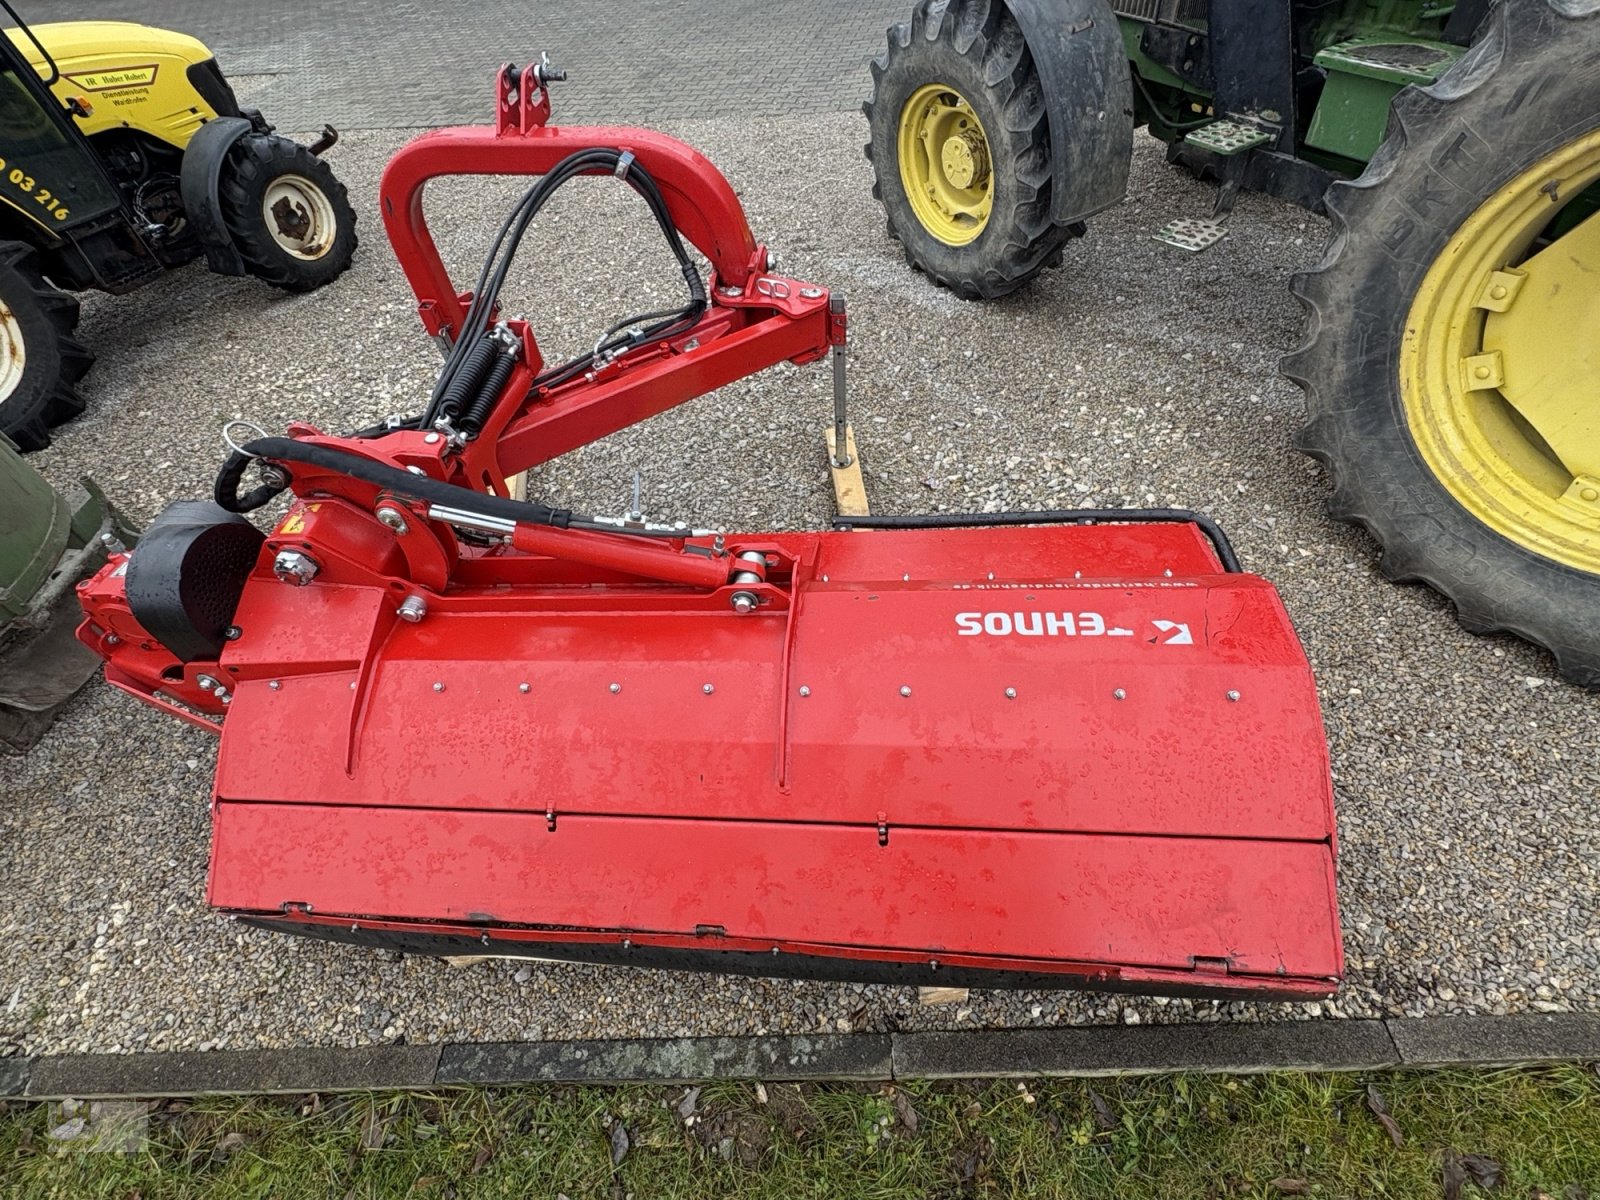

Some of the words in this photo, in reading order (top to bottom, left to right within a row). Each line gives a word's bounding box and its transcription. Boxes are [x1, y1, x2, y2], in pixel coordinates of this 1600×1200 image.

[102, 75, 124, 84] Huber
[124, 73, 148, 81] Robert
[102, 88, 149, 99] Dienstleistung
[113, 97, 148, 107] Waidhofen
[9, 169, 35, 192] 03
[33, 189, 70, 220] 216
[1379, 132, 1478, 252] BKT
